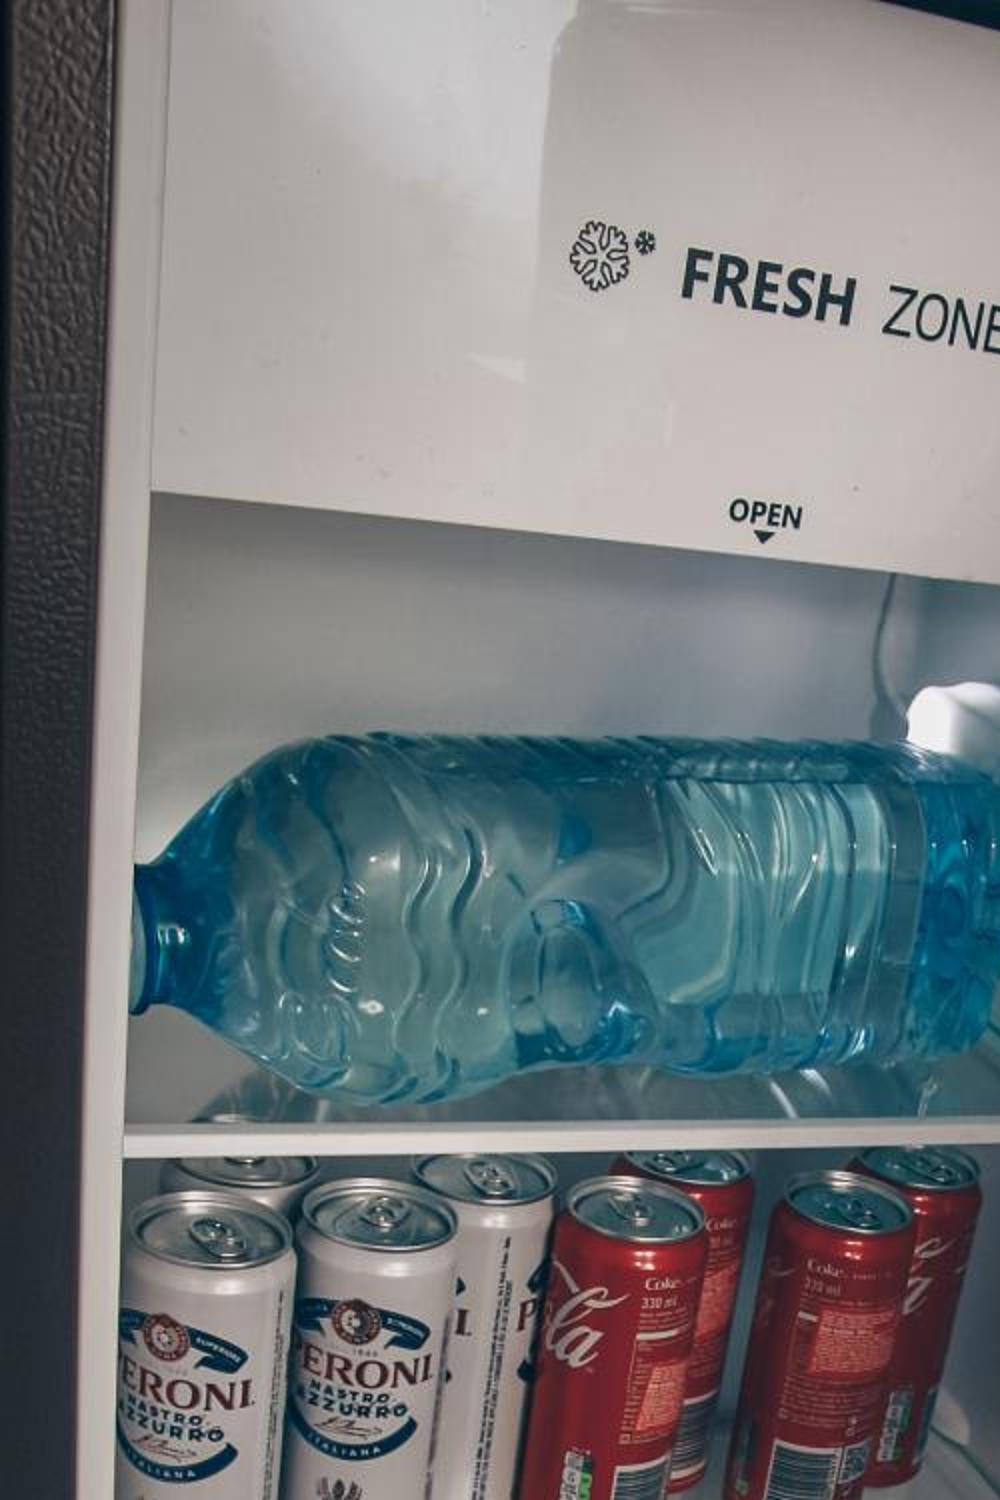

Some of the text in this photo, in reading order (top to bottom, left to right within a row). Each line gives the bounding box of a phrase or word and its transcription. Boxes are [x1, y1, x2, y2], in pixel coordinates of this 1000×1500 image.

[681, 247, 857, 326] FRESH
[729, 498, 803, 529] OPEN
[806, 1258, 842, 1279] Coke
[645, 1277, 681, 1291] Coke
[641, 1297, 663, 1310] 330
[302, 1341, 432, 1389] ERONI
[121, 1354, 252, 1411] ERONI
[309, 1379, 390, 1403] NASTRO
[302, 1388, 408, 1418] ZZURRO
[122, 1403, 225, 1442] ZZURRO
